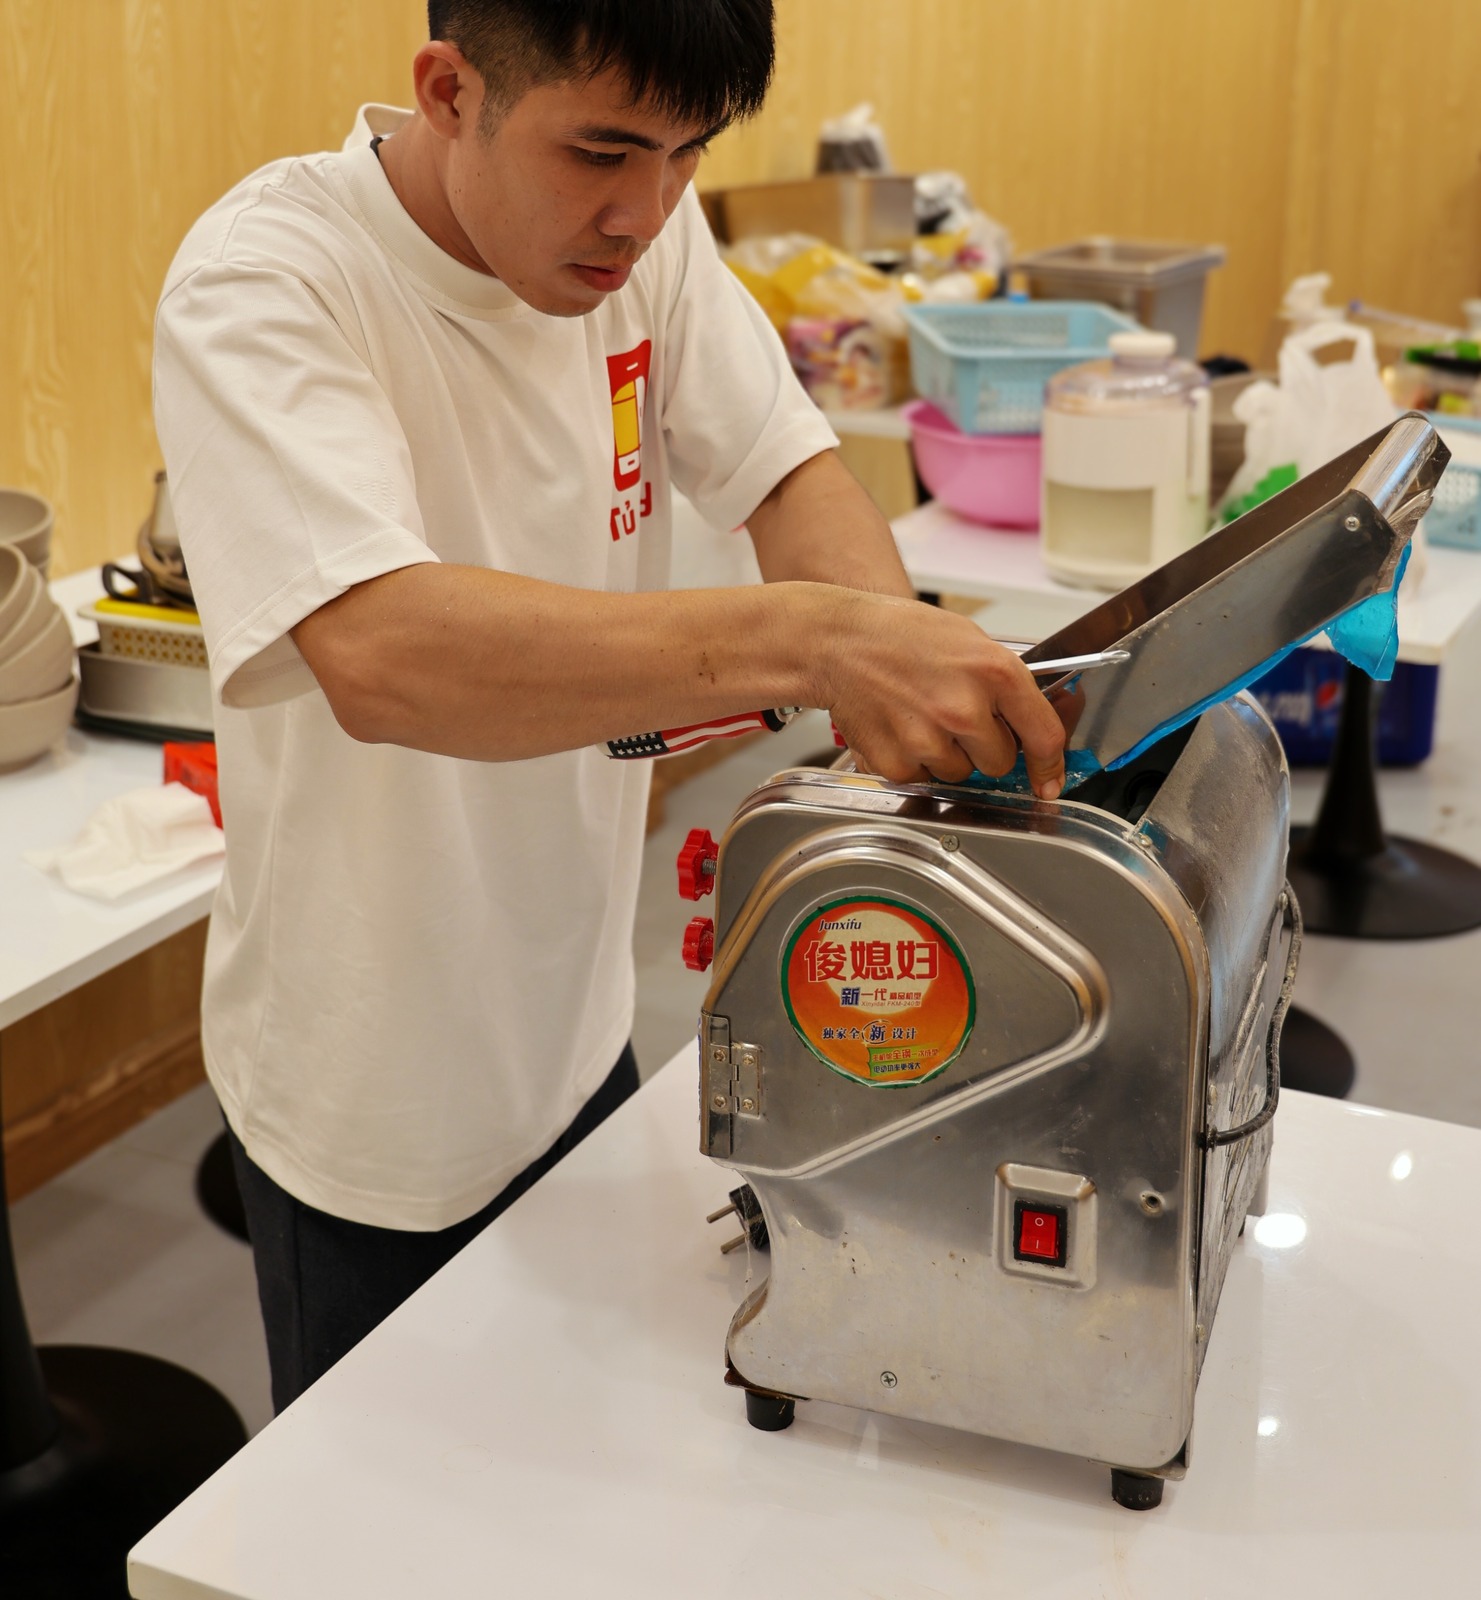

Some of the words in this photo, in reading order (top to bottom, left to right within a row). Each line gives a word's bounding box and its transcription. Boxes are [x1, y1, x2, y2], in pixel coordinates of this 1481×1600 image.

[819, 918, 862, 932] Junxifu
[804, 940, 939, 982] 俊媳妇
